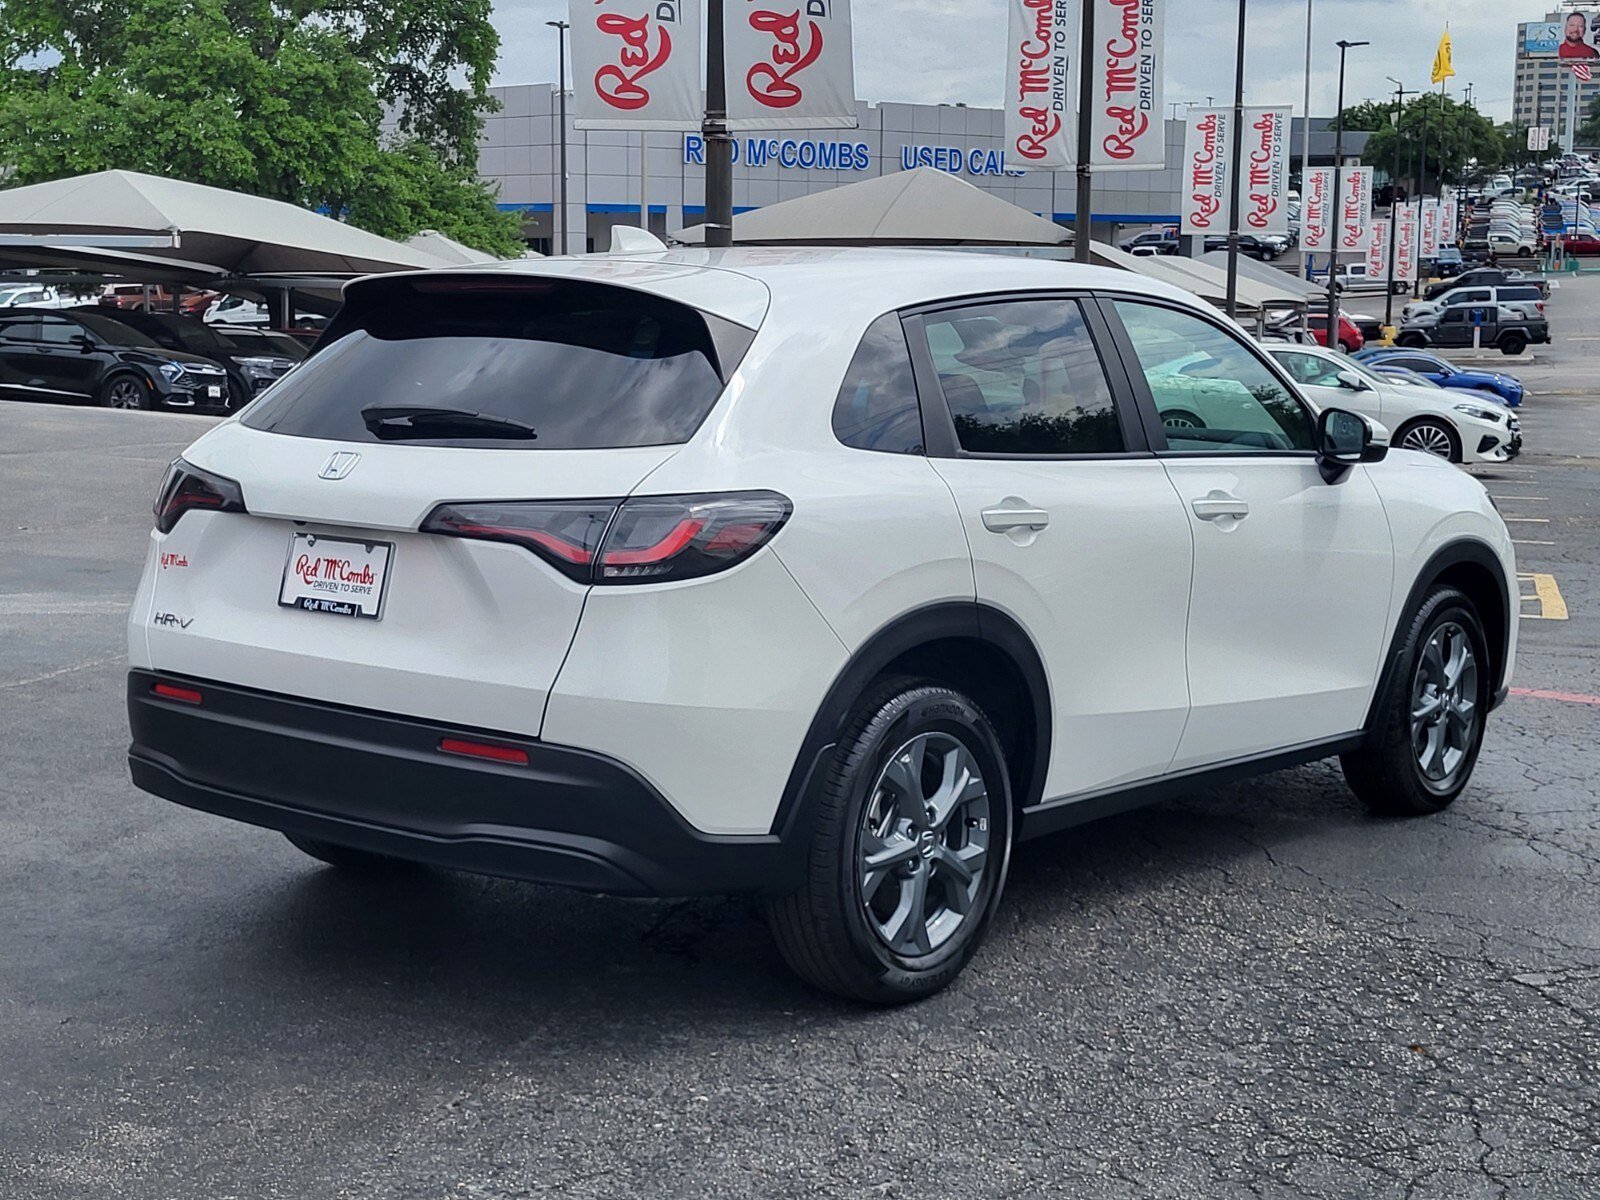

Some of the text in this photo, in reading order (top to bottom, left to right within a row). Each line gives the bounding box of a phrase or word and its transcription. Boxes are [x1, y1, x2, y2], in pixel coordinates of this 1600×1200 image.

[594, 13, 672, 110] Red
[746, 8, 823, 108] Red
[1016, 0, 1061, 160] Red McCom
[1052, 0, 1067, 112] DRIVEN TO SER
[1103, 0, 1148, 160] Red McCom
[1139, 0, 1154, 110] DRIVEN TO SER
[903, 146, 963, 174] USED
[1189, 114, 1220, 228] Red McCombs
[1214, 113, 1226, 197] DRIVEN TO SERVE
[1247, 112, 1277, 228] Red McCombs
[1271, 112, 1283, 197] DRIVEN TO SERVE
[296, 554, 374, 585] Red McCombs
[313, 580, 373, 595] DRIVEN TO SERVE
[154, 611, 194, 629] HR-V
